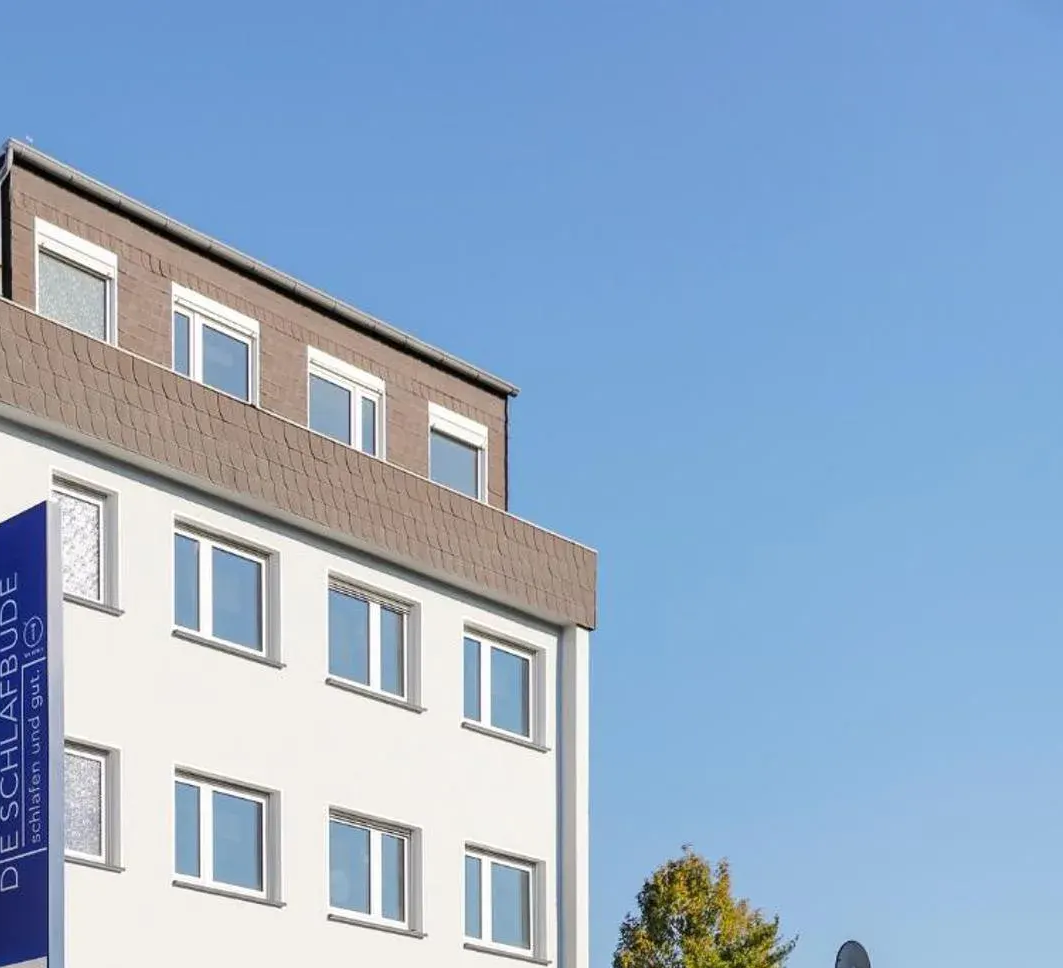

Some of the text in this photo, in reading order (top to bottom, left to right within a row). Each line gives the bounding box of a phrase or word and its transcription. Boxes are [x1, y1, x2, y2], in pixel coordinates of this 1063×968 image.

[30, 669, 43, 709] gut.
[28, 715, 41, 755] und
[28, 760, 41, 844] schlafen
